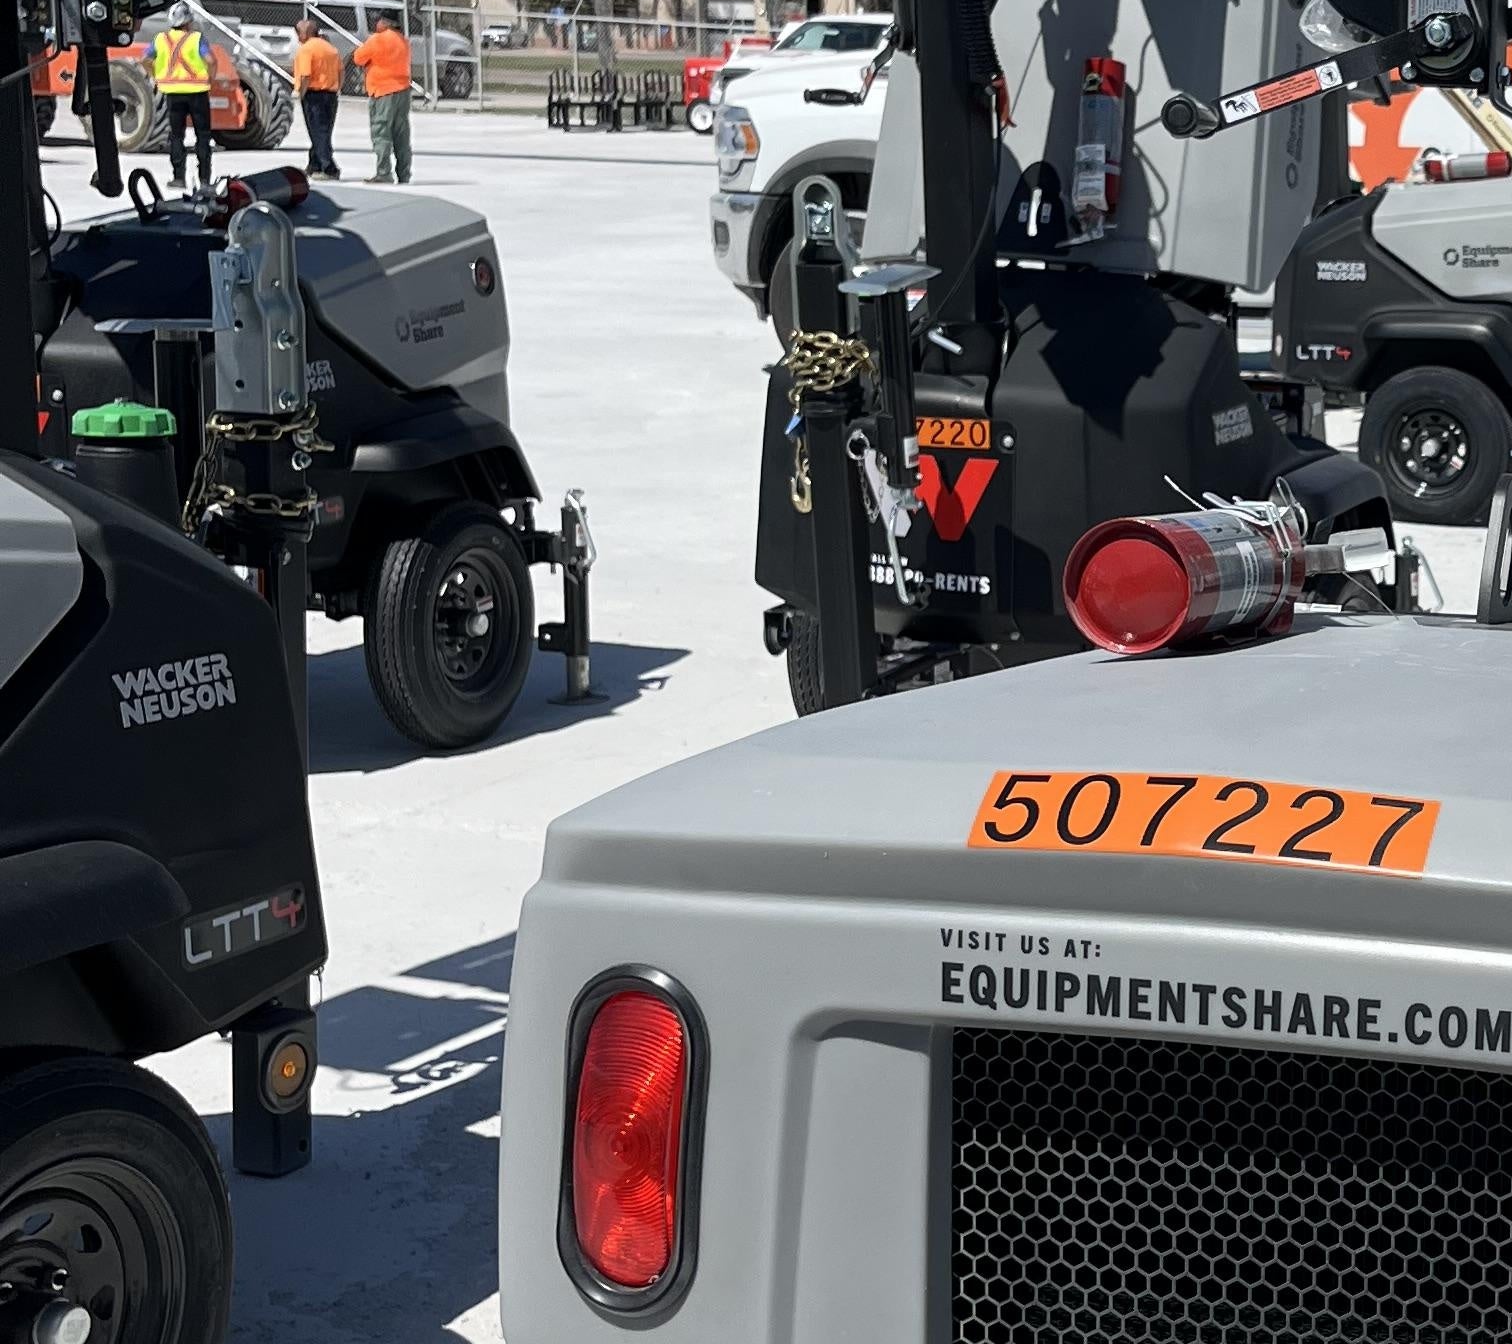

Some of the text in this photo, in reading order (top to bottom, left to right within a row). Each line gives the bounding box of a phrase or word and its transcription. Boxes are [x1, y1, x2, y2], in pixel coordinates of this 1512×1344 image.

[1316, 260, 1366, 272] WACKER
[1317, 270, 1367, 282] NEUSON
[1462, 257, 1499, 269] Share
[1296, 343, 1352, 361] LTT4
[111, 653, 232, 699] WACKER
[119, 678, 237, 728] NEUSON
[984, 773, 1425, 868] 507227
[184, 896, 301, 964] LTT4
[940, 928, 1101, 959] VISIT US AT:
[941, 961, 1512, 1053] EQUIPMENTSHARE.COM
